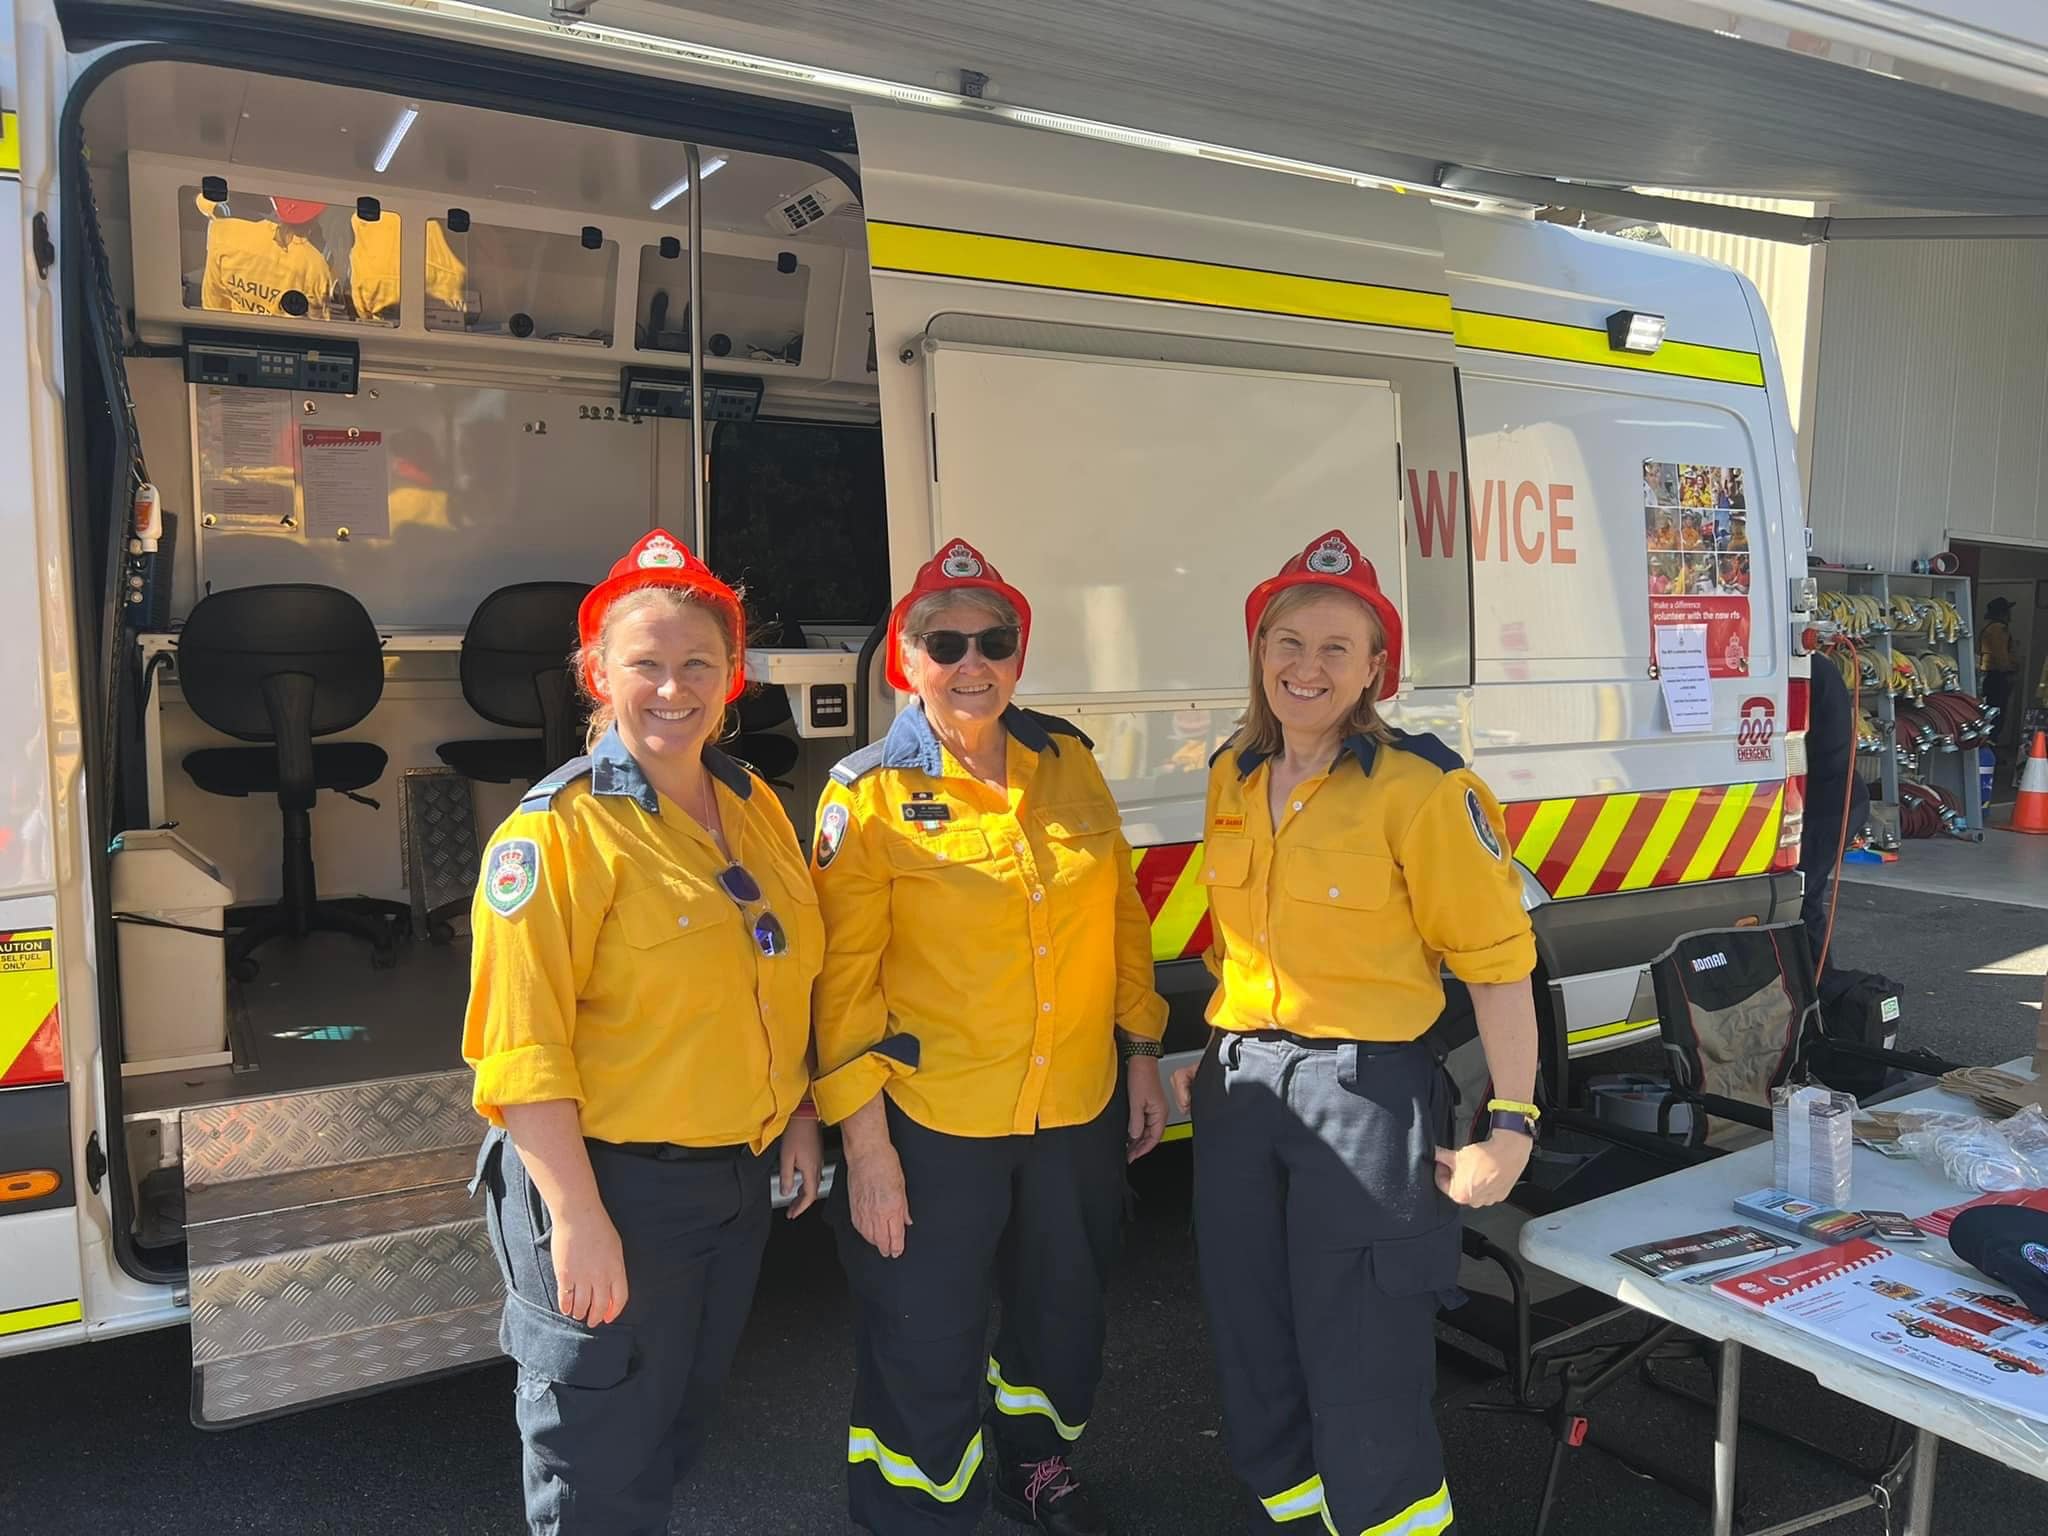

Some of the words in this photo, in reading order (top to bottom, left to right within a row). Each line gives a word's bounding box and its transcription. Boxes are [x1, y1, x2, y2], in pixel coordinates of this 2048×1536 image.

[1405, 469, 1458, 558] W
[1653, 611, 1686, 621] volunteer
[1687, 611, 1702, 620] with
[1702, 611, 1714, 620] the
[1738, 748, 1772, 760] EMERGENCY
[19, 953, 41, 961] FUEL
[3, 962, 26, 970] ONLY
[1639, 1253, 1663, 1263] HOW
